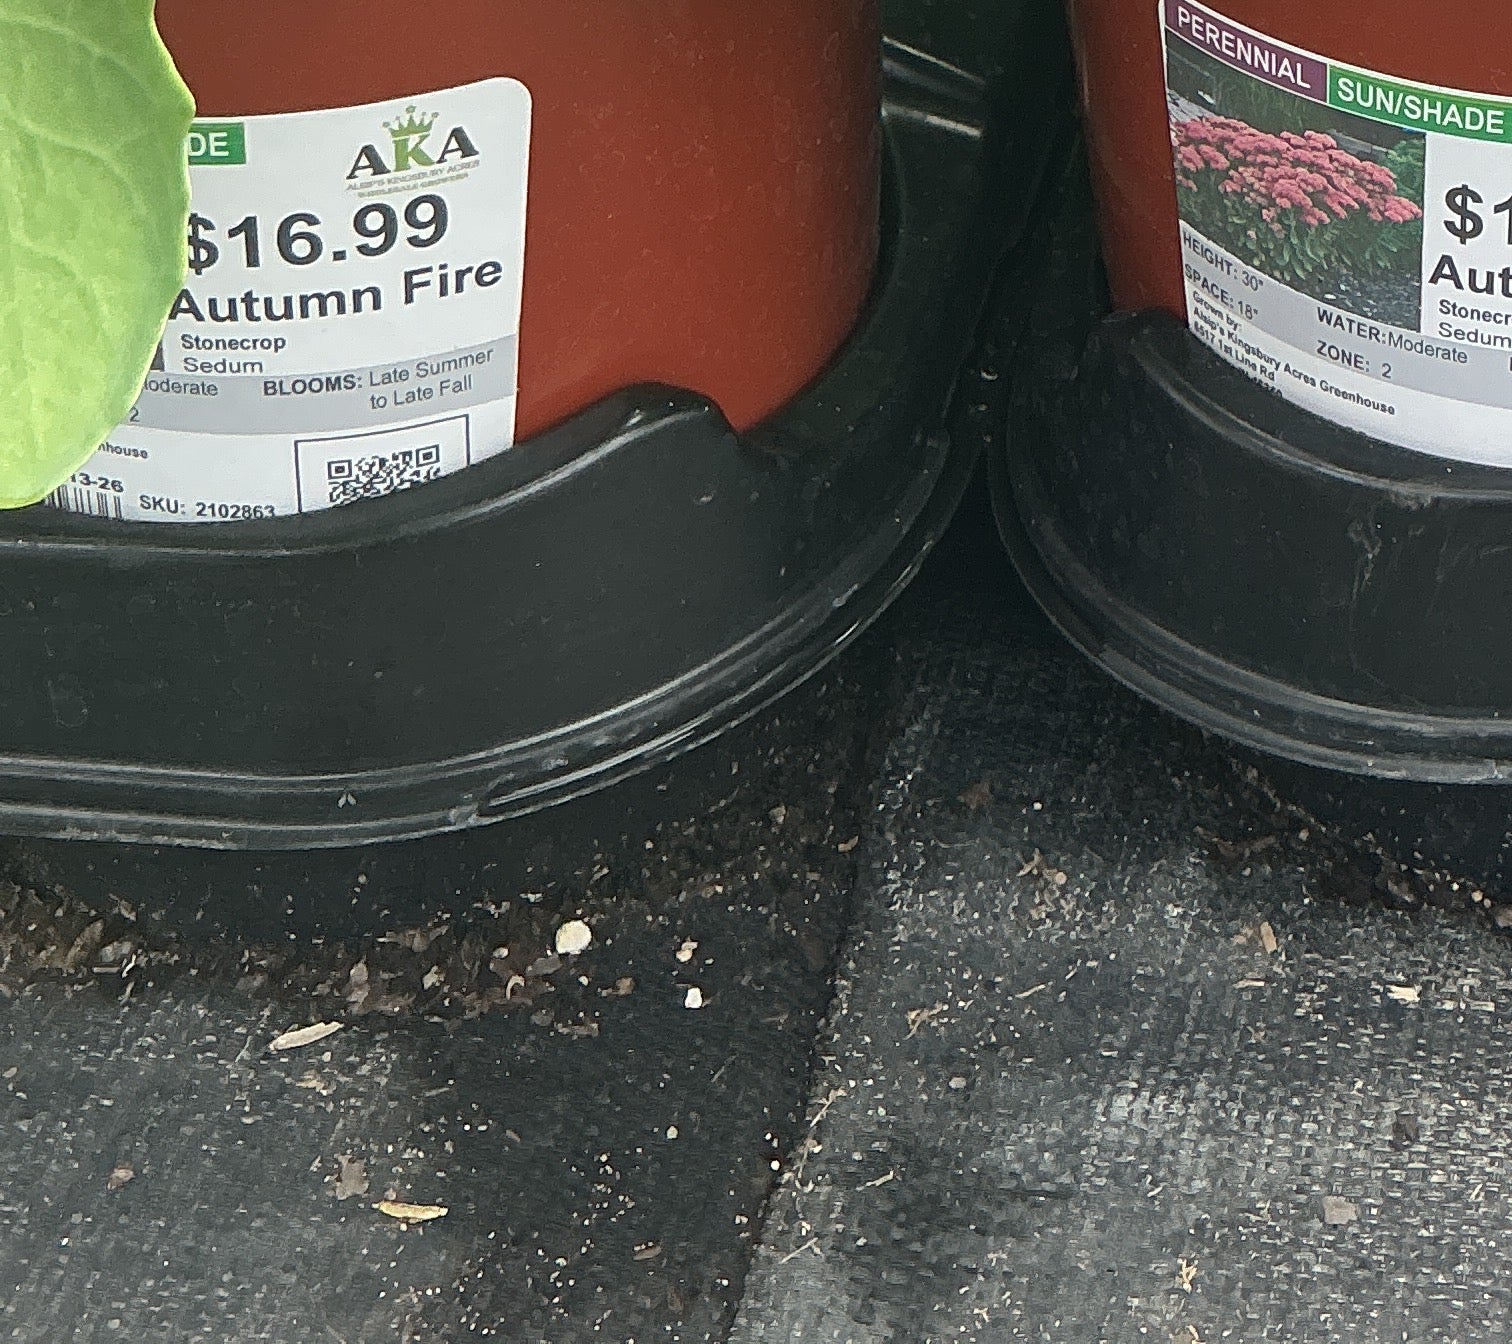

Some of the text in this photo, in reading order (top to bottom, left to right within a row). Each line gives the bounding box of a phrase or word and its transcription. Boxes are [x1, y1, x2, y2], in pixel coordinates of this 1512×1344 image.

[1177, 6, 1311, 89] PERENNIAL
[1337, 77, 1504, 134] SUN/SHADE
[346, 126, 480, 180] AKA
[187, 193, 449, 275] $16.99
[1182, 231, 1264, 291] HEIGHT: 30"
[168, 260, 503, 323] Autumn Fire
[1184, 263, 1258, 320] SPACE: 18"
[1193, 290, 1225, 321] Grown
[180, 333, 286, 353] Stonecrop
[1438, 322, 1512, 349] Sedum
[183, 357, 263, 374] Sedum
[263, 348, 494, 396] BLOOMS: Late Summer
[1227, 330, 1281, 372] Kingsbury
[1283, 363, 1317, 388] Acres
[1320, 380, 1396, 415] Greenhouse
[1260, 367, 1275, 381] Rd
[1316, 340, 1392, 379] ZONE: 2
[145, 378, 219, 396] oderate
[370, 374, 472, 409] to Late Fall
[129, 406, 140, 422] 2
[139, 494, 275, 519] SKU: 2102863
